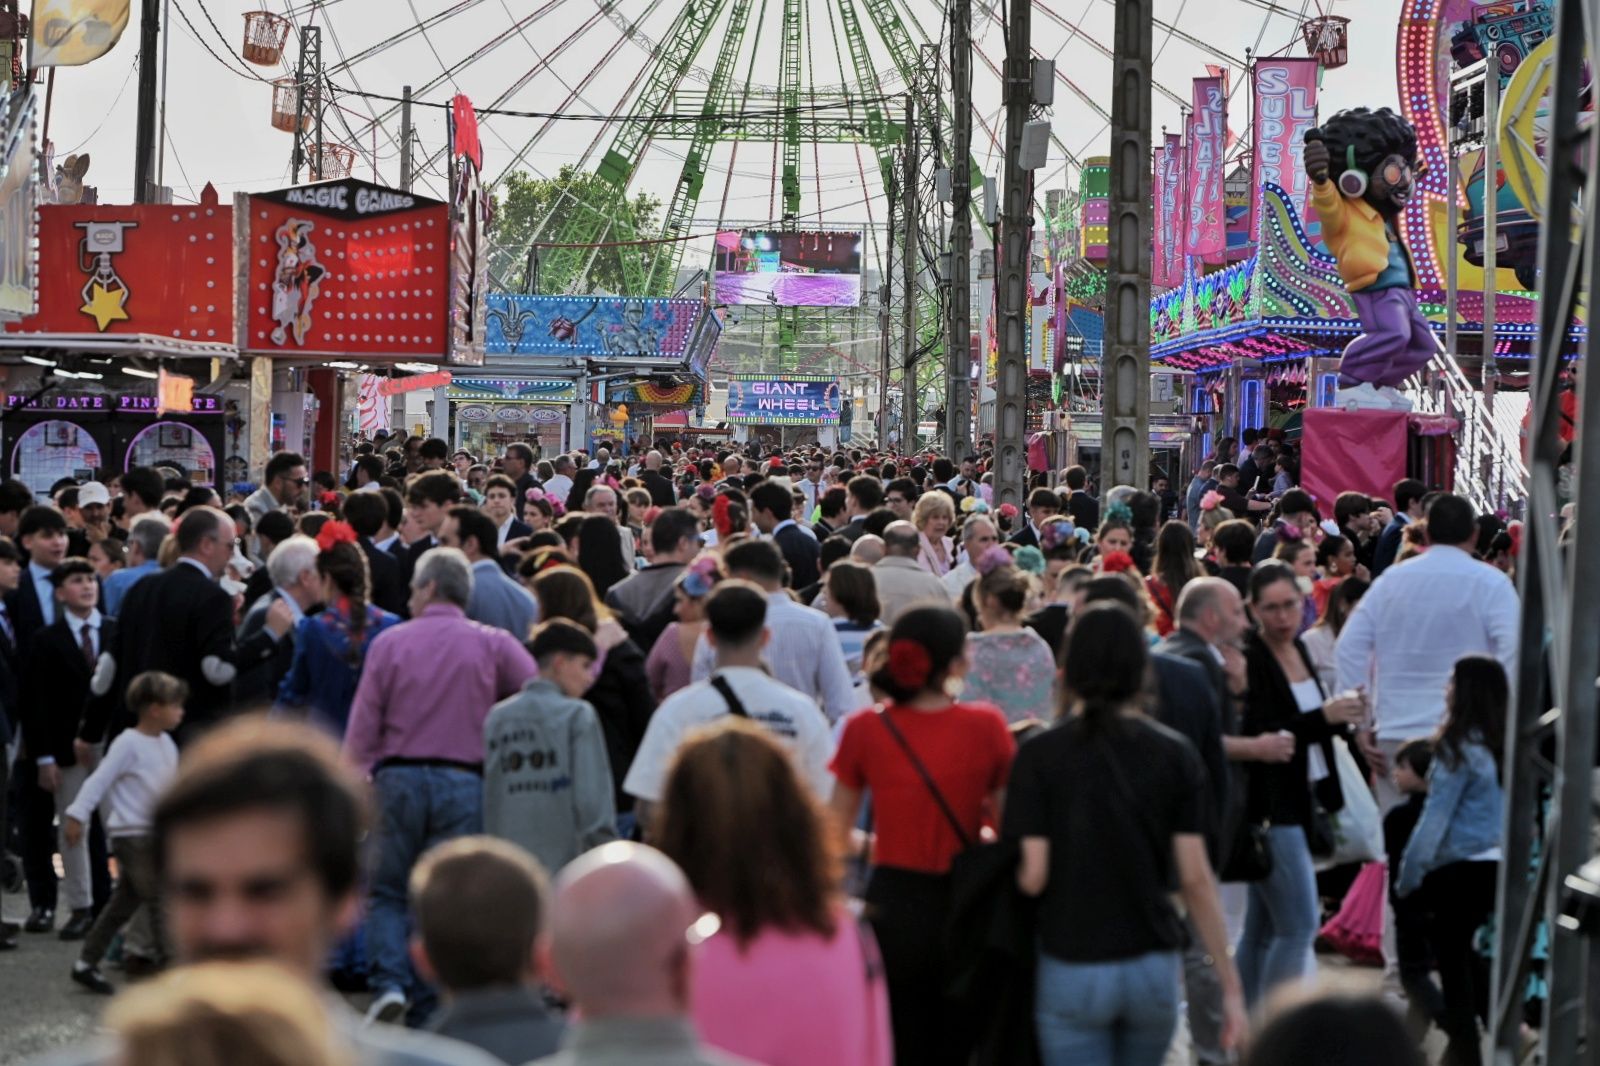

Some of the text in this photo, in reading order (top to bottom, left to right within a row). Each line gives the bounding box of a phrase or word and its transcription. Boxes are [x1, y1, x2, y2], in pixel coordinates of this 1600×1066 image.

[1257, 68, 1290, 186] SUPER
[286, 186, 415, 214] MAGIC GAMES
[752, 382, 808, 395] GIANT
[57, 397, 102, 408] DATE
[758, 398, 819, 410] WHEEL
